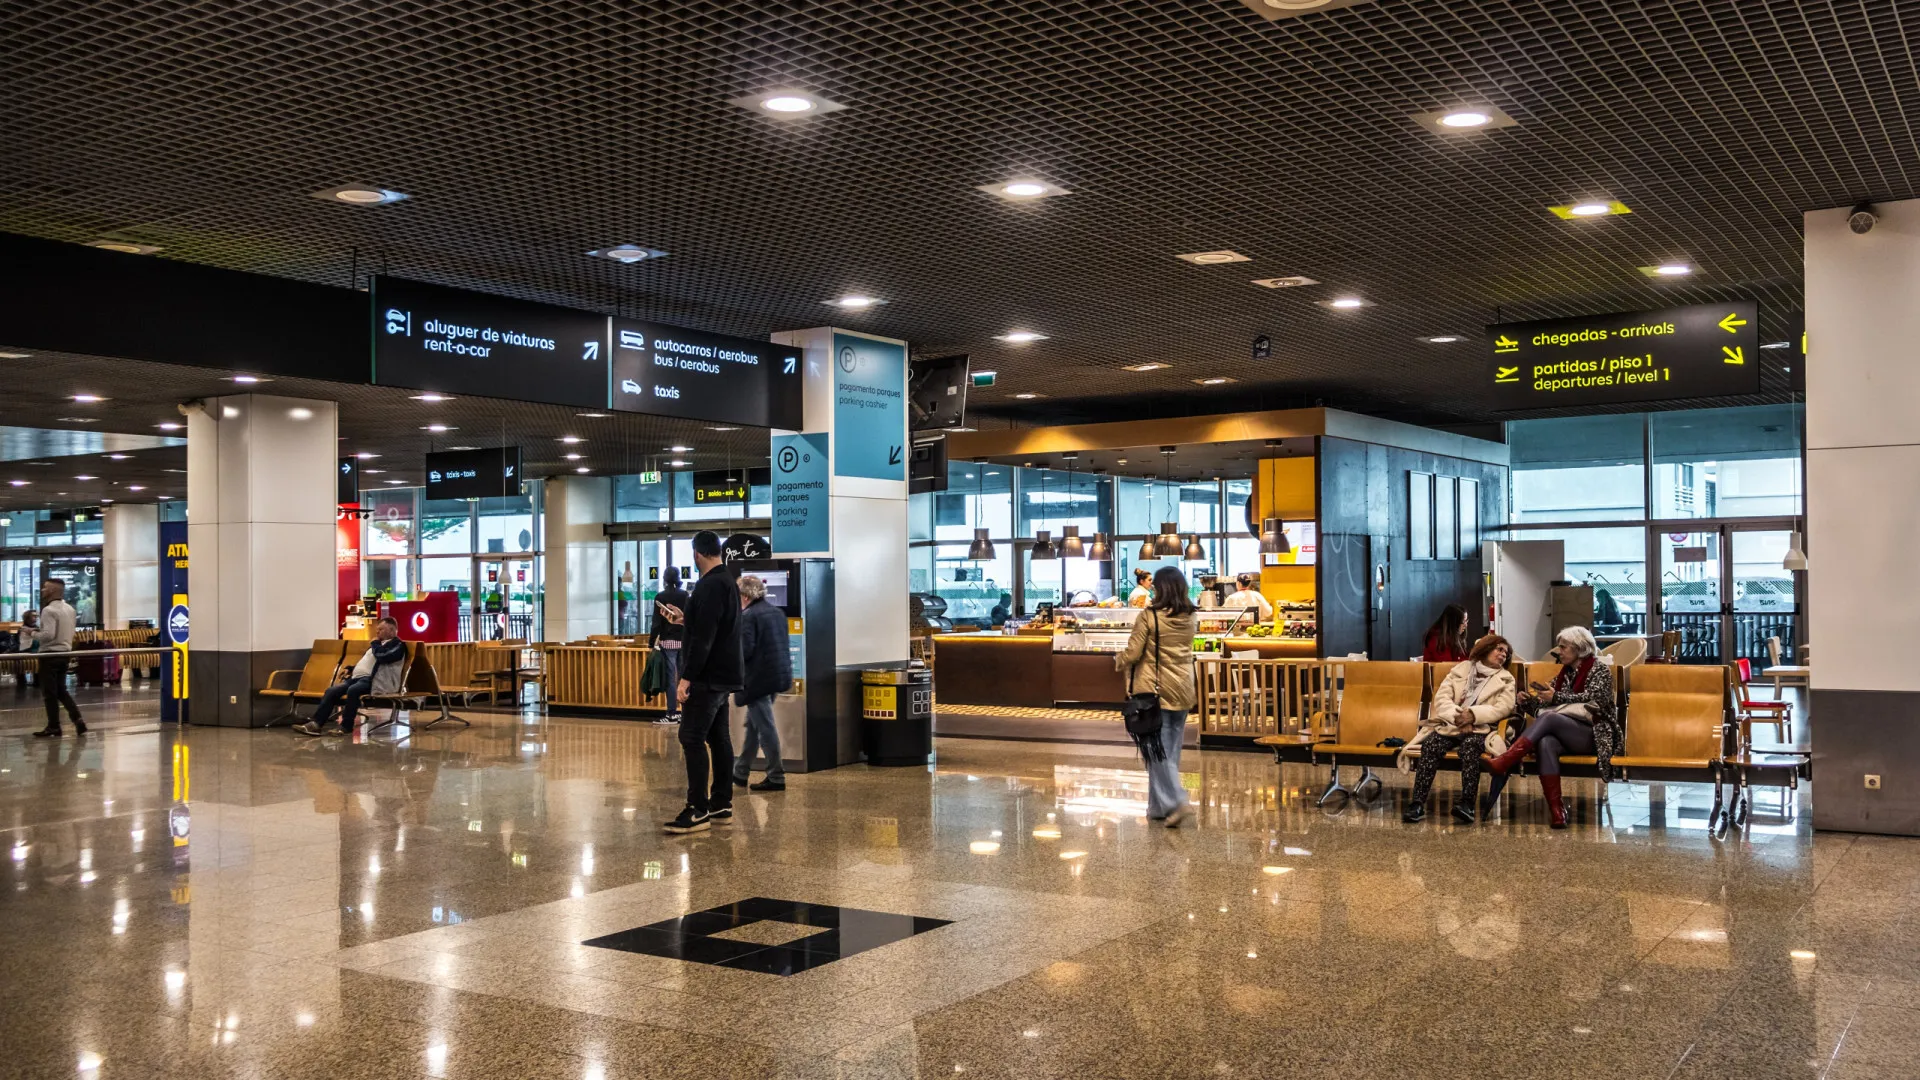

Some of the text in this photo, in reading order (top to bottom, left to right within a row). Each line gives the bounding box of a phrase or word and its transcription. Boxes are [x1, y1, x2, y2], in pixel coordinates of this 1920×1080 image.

[423, 318, 556, 351] aluguer de viaturas
[1532, 328, 1608, 347] chegadas
[1620, 321, 1676, 338] arrivals
[424, 339, 491, 358] rent-a-car
[654, 338, 712, 358] autocarros
[718, 350, 759, 365] aerobus
[654, 352, 673, 367] bus
[680, 359, 720, 374] aerobus
[1533, 359, 1598, 379] partidas
[1609, 355, 1642, 373] piso
[1645, 353, 1652, 367] 1
[1533, 375, 1613, 392] departures
[1624, 369, 1658, 384] level
[1662, 367, 1670, 381] 1
[654, 384, 680, 399] taxis
[839, 383, 901, 398] pagamento parques
[839, 397, 888, 410] parking cashier
[777, 481, 824, 492] pagamento
[777, 494, 810, 504] parques
[777, 507, 808, 517] parking
[777, 519, 806, 527] cashier
[725, 539, 760, 566] go to
[174, 560, 189, 568] HER
